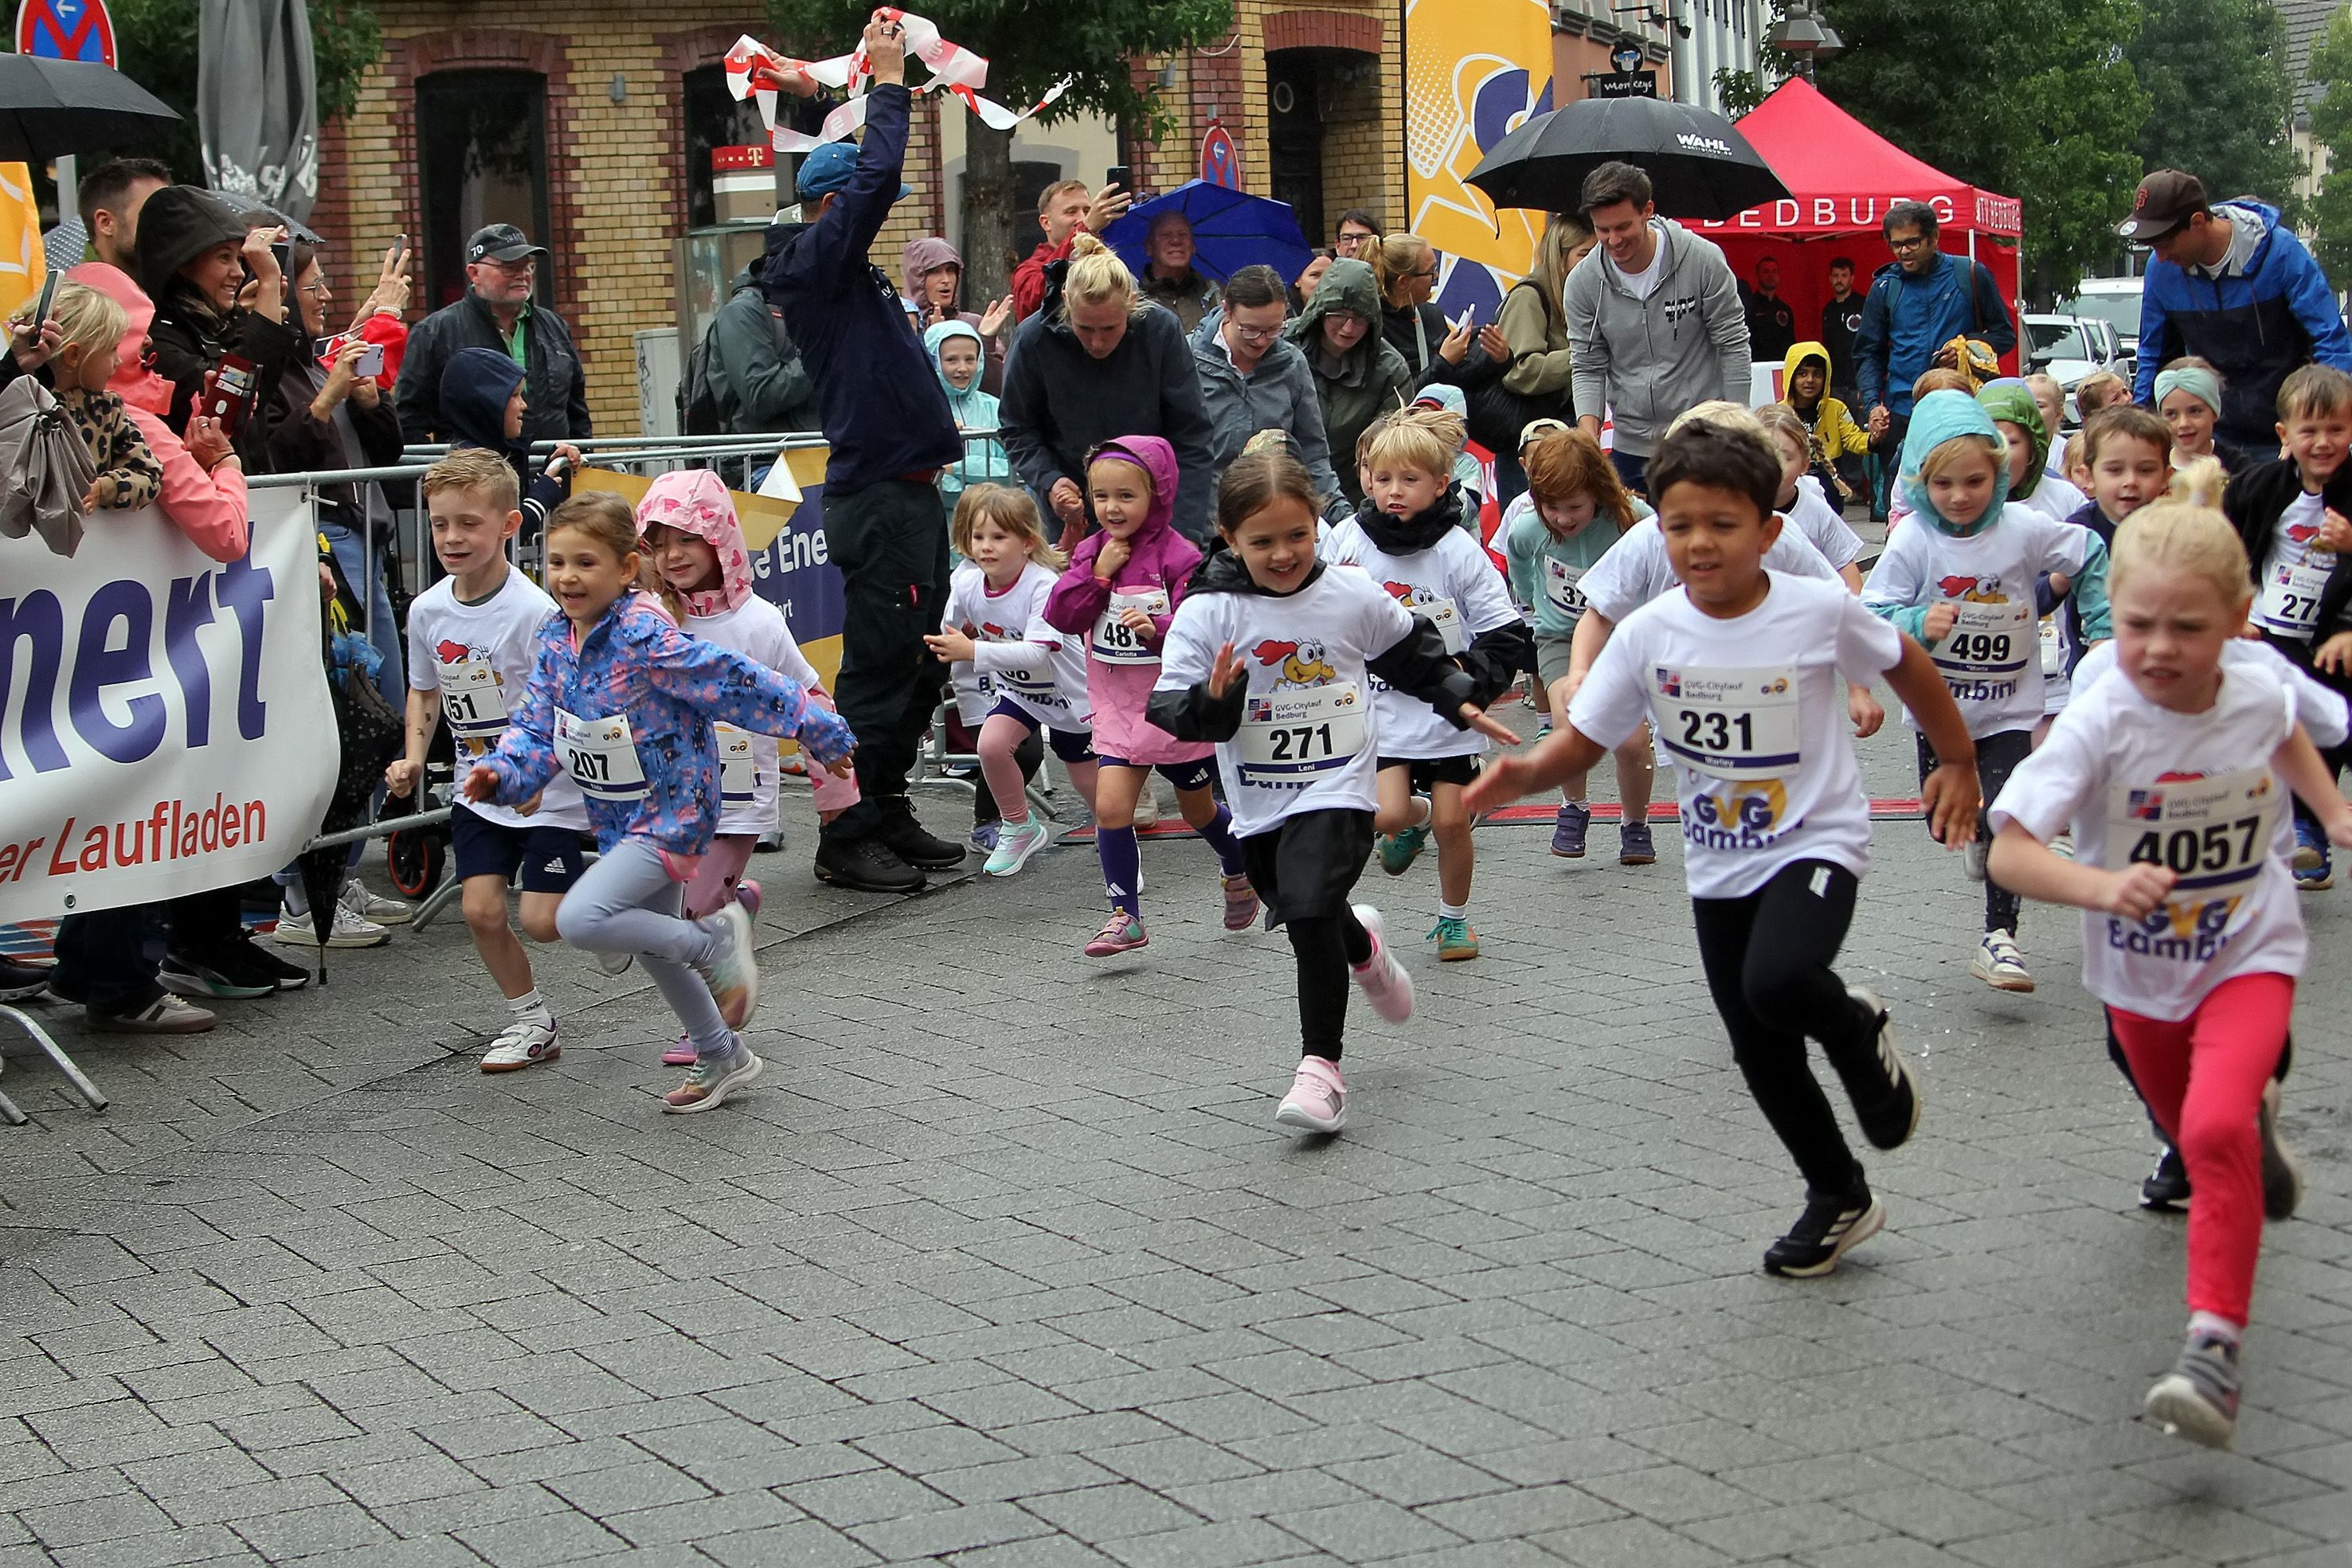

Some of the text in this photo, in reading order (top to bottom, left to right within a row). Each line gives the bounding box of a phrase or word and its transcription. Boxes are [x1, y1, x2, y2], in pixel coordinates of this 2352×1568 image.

[1676, 133, 1731, 151] WAHL
[1704, 195, 1954, 227] EDBUG
[471, 244, 483, 256] 70
[777, 526, 828, 573] Ene
[2280, 594, 2321, 621] 27
[1950, 634, 2010, 662] 499
[1275, 699, 1322, 712] GVG-Citylauf
[1276, 711, 1308, 721] Bedburg
[1270, 723, 1333, 761] 271
[1679, 710, 1753, 751] 231
[569, 749, 610, 781] 207
[1298, 764, 1315, 772] Leni
[1693, 793, 1772, 830] GVG
[48, 792, 266, 876] Laufladen
[2131, 815, 2259, 873] 4057
